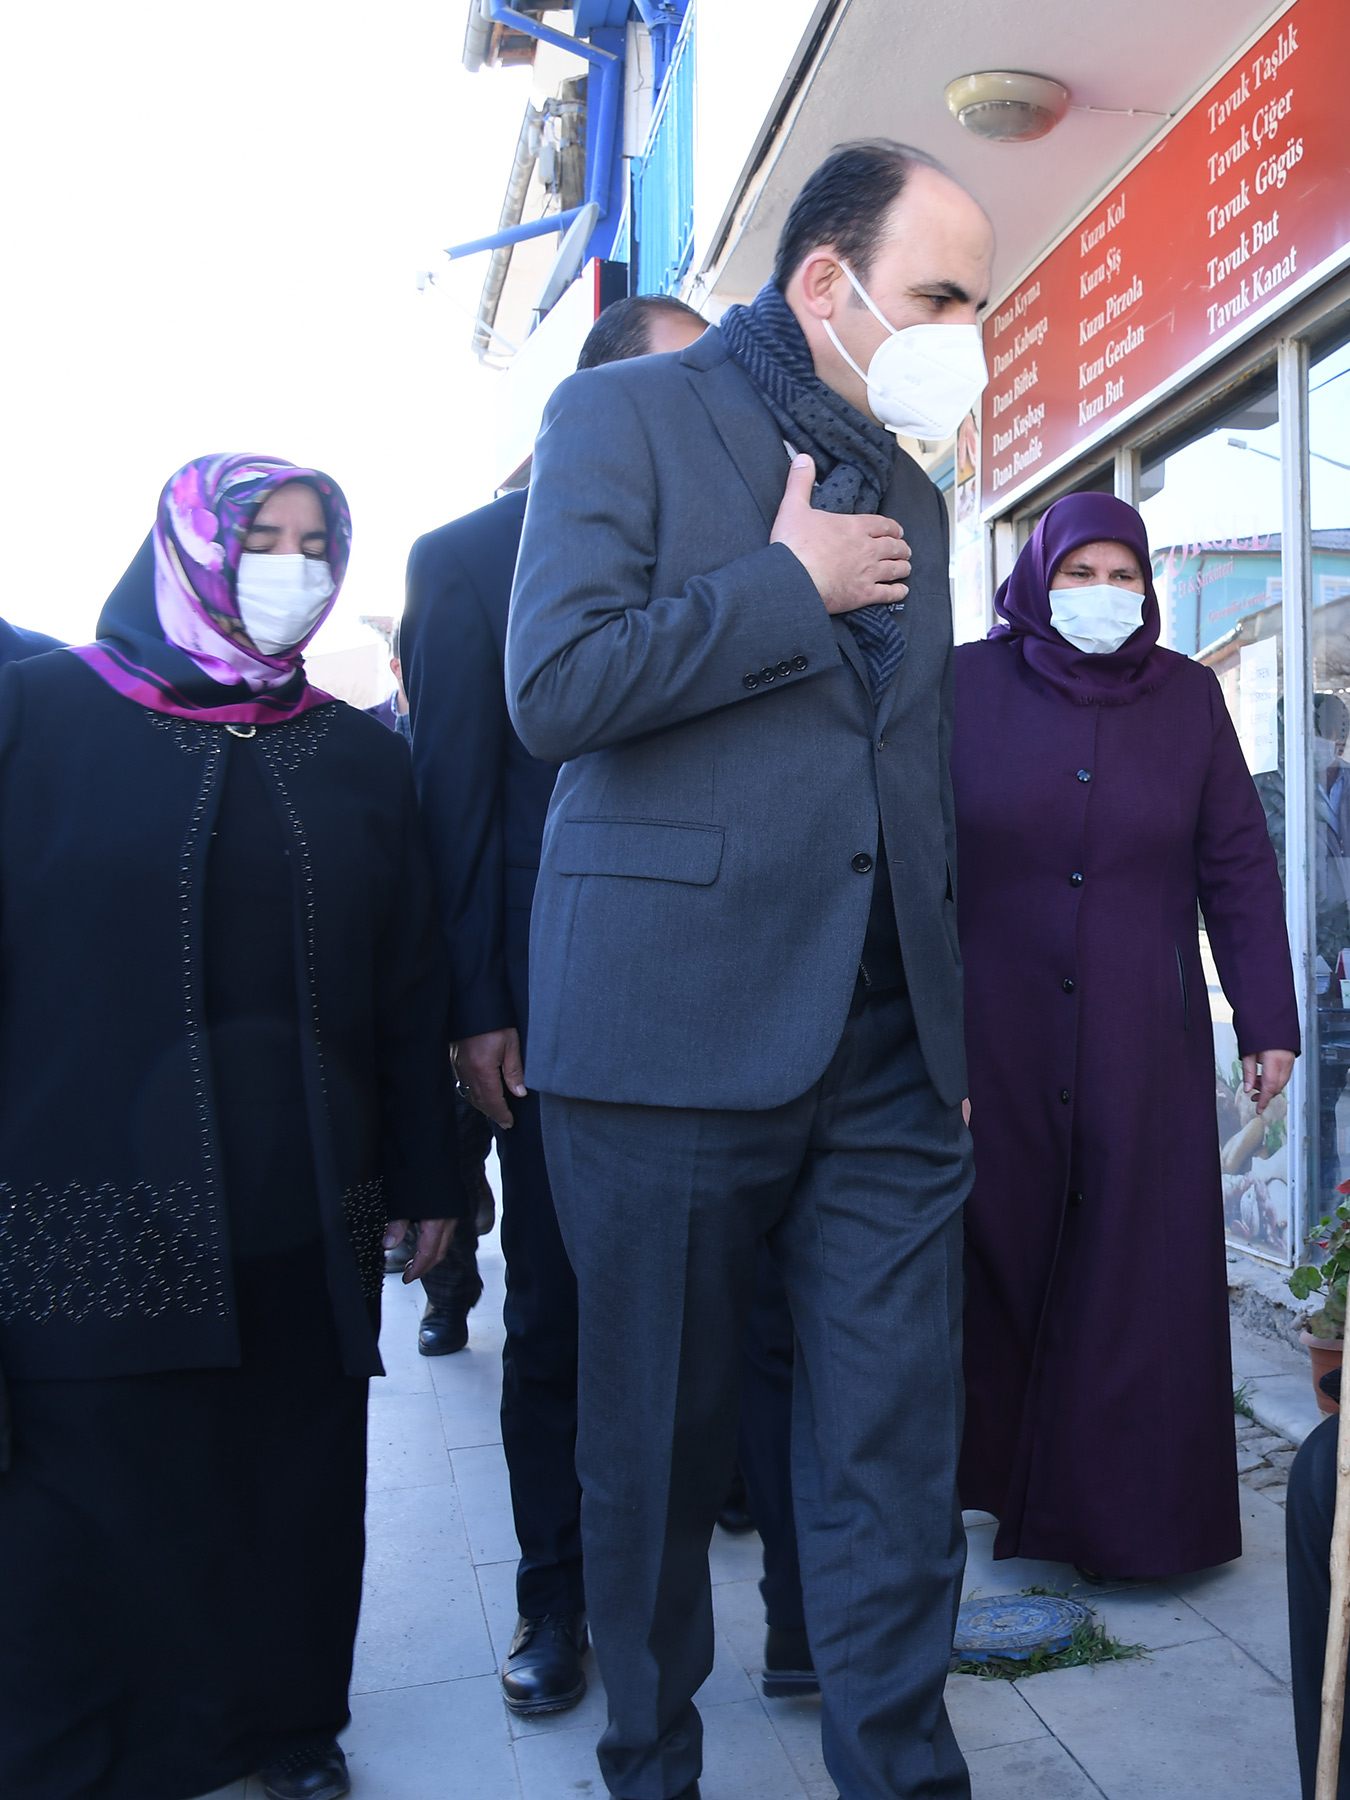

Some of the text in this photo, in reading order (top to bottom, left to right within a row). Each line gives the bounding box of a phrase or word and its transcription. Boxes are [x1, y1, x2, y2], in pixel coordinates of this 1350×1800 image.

[1207, 22, 1299, 134] Tavuk Taşlık
[1207, 89, 1293, 185] Tavuk Çiğer
[1080, 192, 1125, 258] Kuzu Kol
[1207, 179, 1250, 238] Tavuk
[1080, 246, 1121, 299] Kuzu Şiş
[1207, 210, 1279, 289] Tavuk But
[993, 282, 1041, 338] Dana Kıyma
[1079, 275, 1143, 346] Kuzu Pirzola
[1207, 245, 1297, 335] Tavuk Kanat
[993, 316, 1048, 379] Dana Kaburga
[1079, 325, 1144, 390] Kuzu Gerdan
[993, 389, 1013, 418] Dana
[1078, 376, 1124, 427] Kuzu But
[992, 428, 1013, 457] Dana
[992, 464, 1013, 491] Dana
